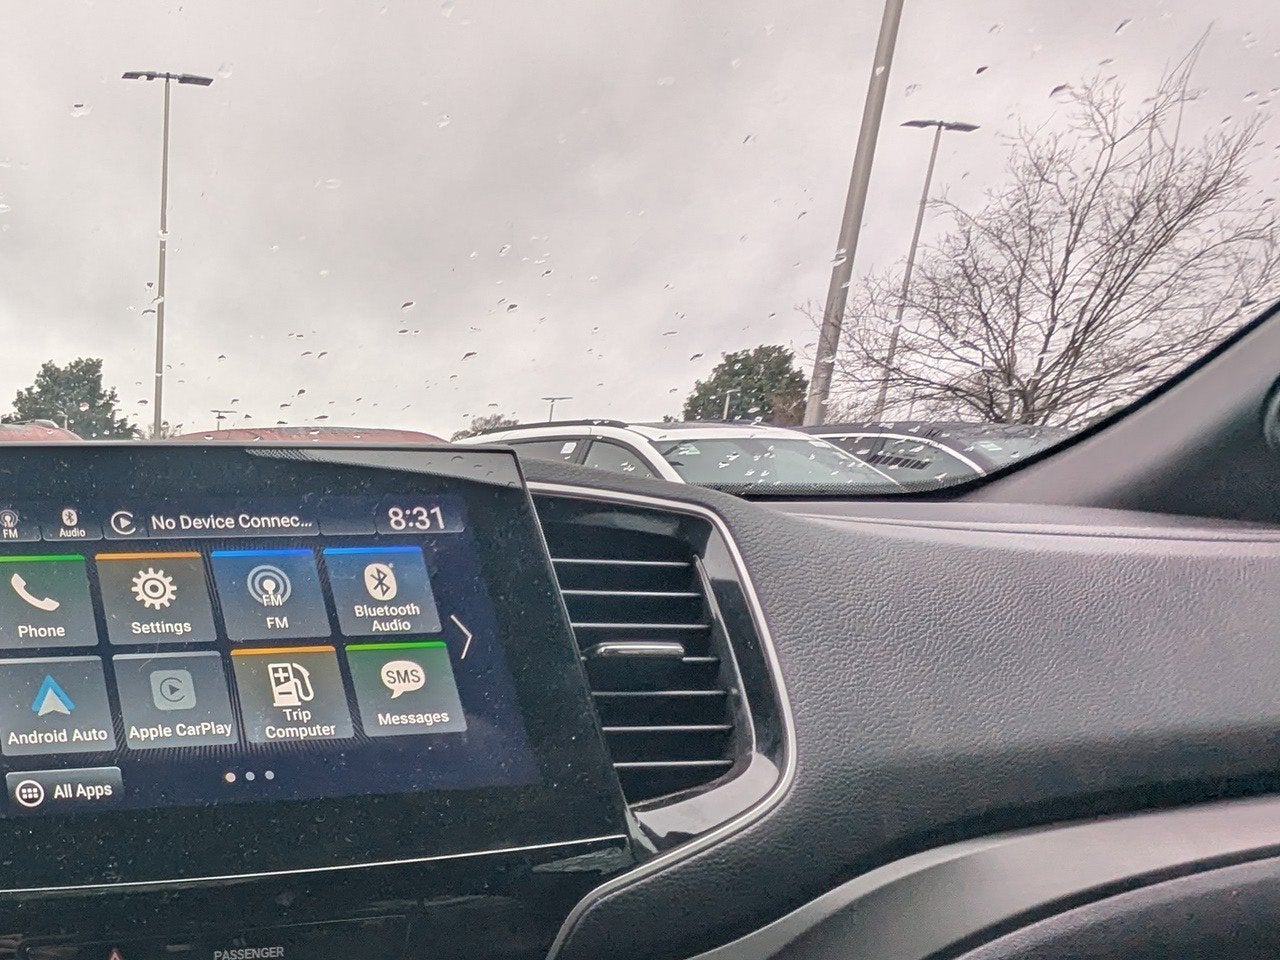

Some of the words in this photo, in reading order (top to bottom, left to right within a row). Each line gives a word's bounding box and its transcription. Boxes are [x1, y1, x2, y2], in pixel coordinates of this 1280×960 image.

[151, 516, 175, 530] No
[180, 514, 235, 530] Device
[388, 506, 445, 530] 8:31
[3, 529, 18, 539] FM
[59, 528, 86, 538] Audio
[354, 603, 420, 618] Bluetooth
[131, 621, 192, 635] Settings
[266, 617, 289, 629] FM
[371, 619, 412, 631] Audio
[18, 625, 66, 638] Phone
[386, 669, 421, 684] SMS
[283, 708, 312, 723] Trip
[377, 711, 450, 726] Messages
[7, 729, 68, 746] Android
[72, 728, 108, 743] Auto
[129, 724, 172, 742] Apple
[176, 721, 232, 738] CarPlay
[265, 724, 336, 740] Computer
[54, 784, 72, 798] All
[76, 783, 113, 800] Apps
[214, 946, 284, 960] PASSENGER
